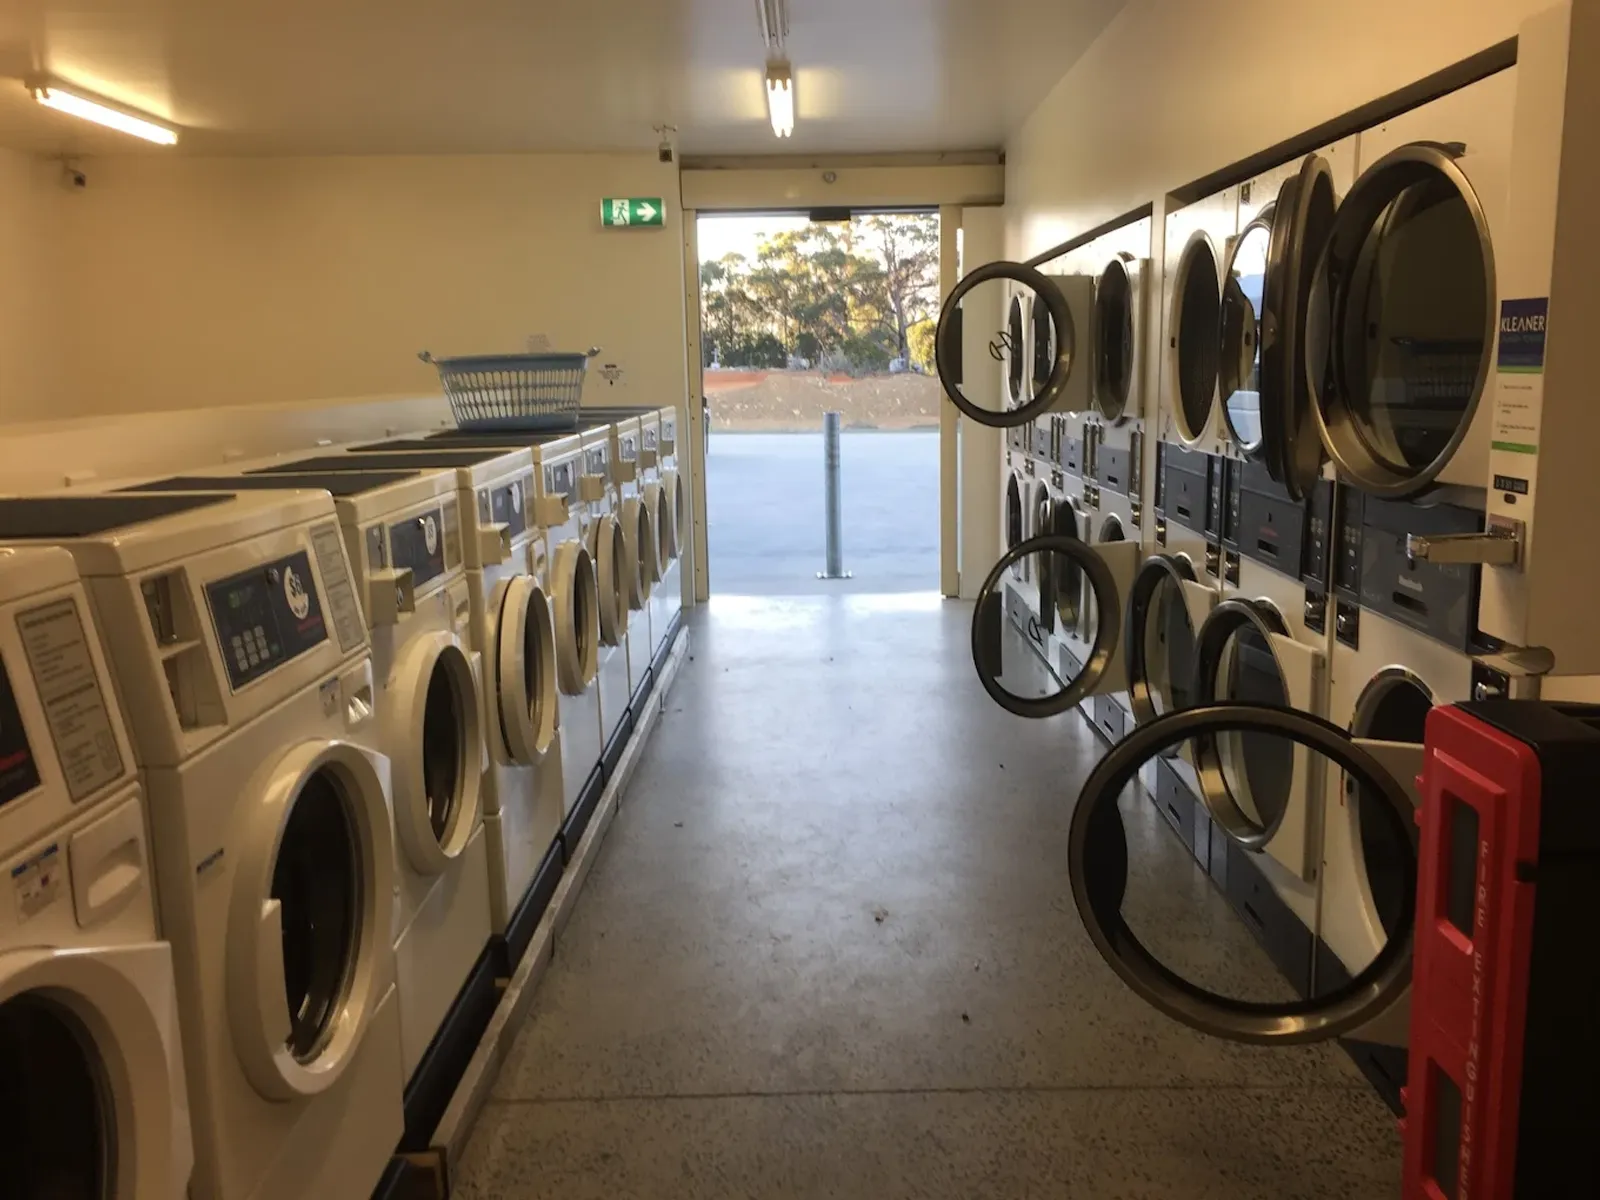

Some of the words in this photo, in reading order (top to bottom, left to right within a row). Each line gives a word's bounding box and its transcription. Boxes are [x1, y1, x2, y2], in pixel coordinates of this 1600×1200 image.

[1501, 315, 1545, 332] KLEANER
[1477, 841, 1489, 928] FIRE
[1460, 951, 1483, 1200] EXTINGUISHER
